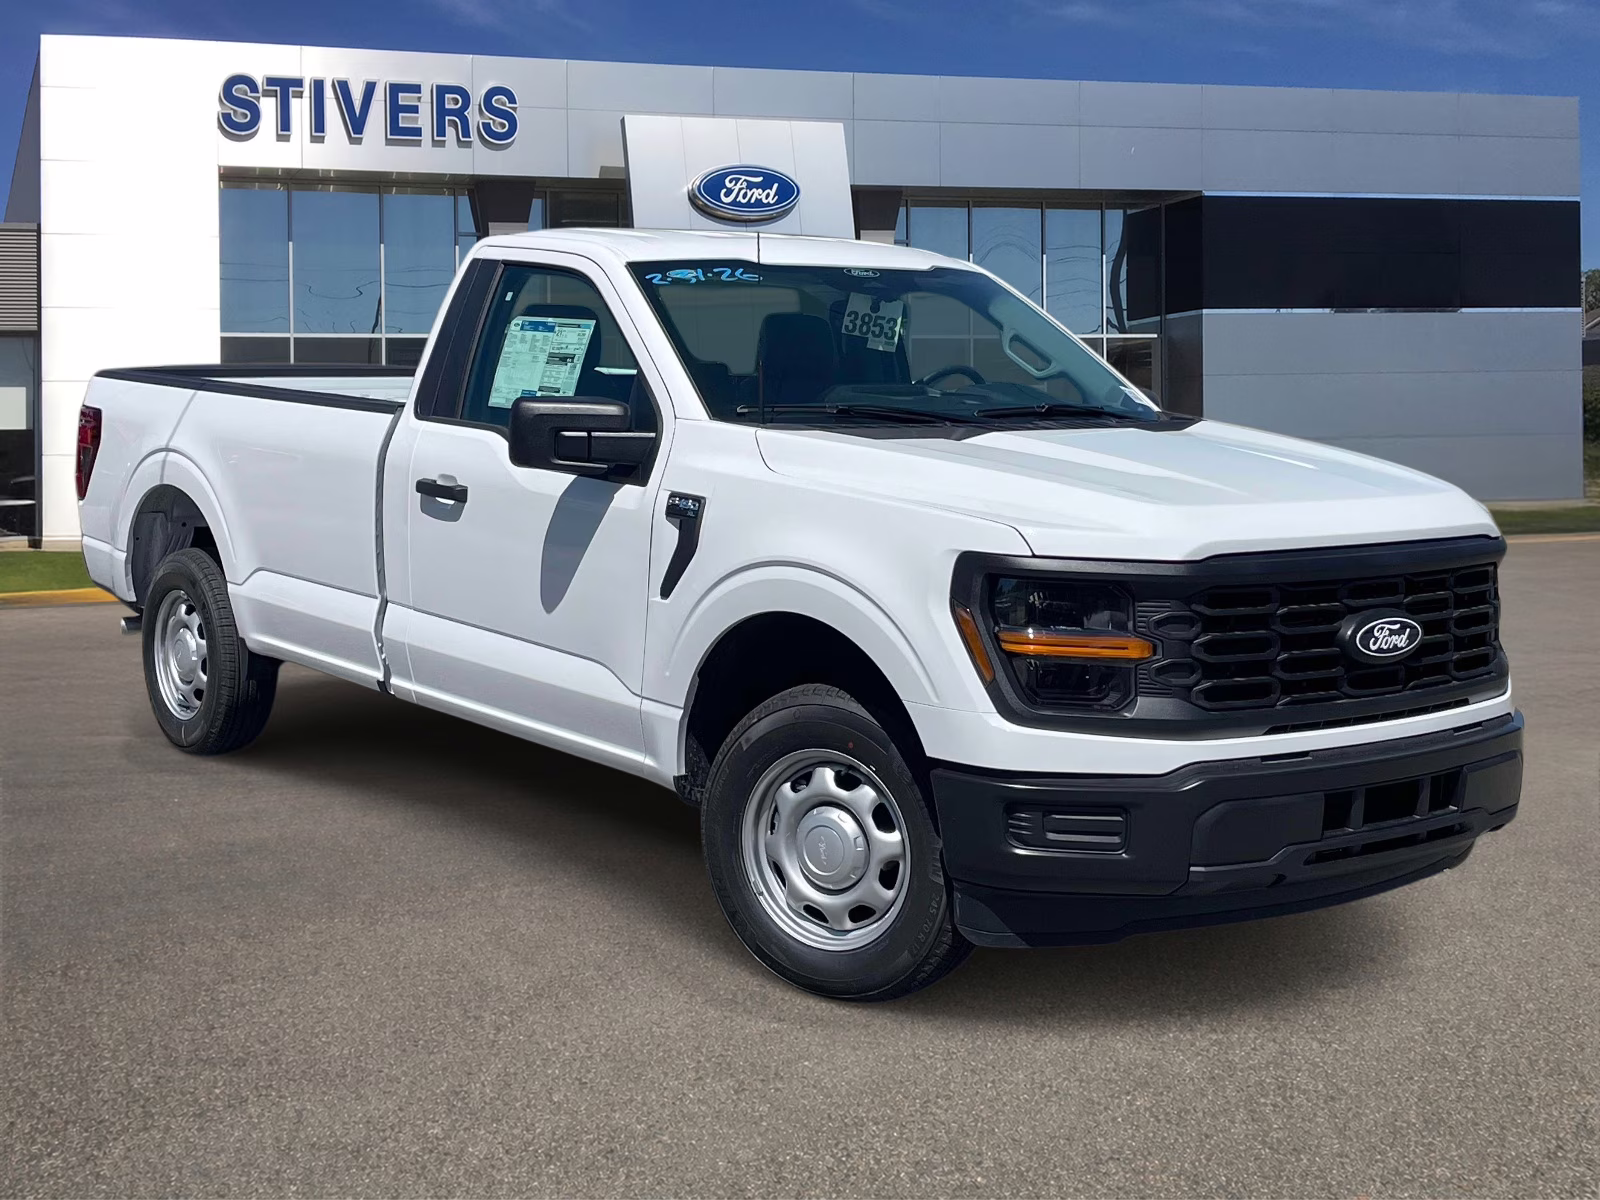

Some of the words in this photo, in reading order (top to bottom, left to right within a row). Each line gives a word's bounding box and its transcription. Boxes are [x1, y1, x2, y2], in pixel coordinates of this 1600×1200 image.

[219, 73, 519, 145] STIVERS
[720, 174, 778, 204] Ford
[844, 310, 897, 341] 3853
[1369, 623, 1411, 651] Ford
